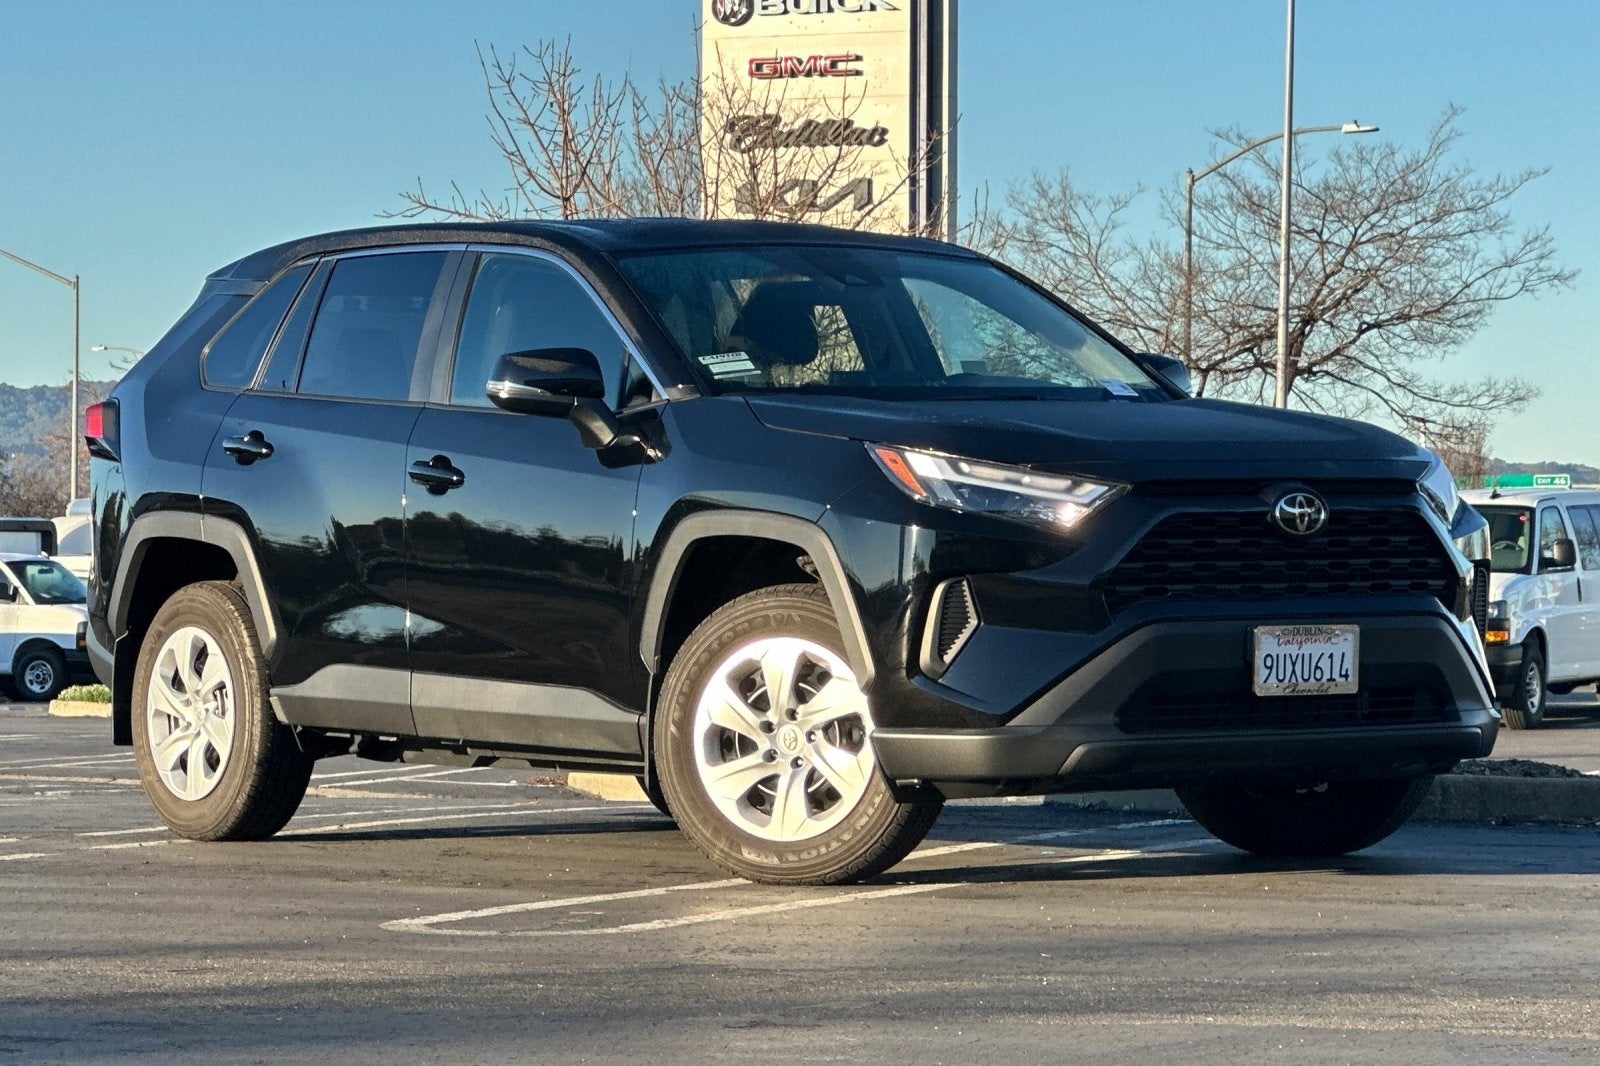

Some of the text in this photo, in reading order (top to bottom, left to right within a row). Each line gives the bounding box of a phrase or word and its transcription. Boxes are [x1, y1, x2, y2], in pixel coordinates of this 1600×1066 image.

[748, 53, 863, 79] GMC
[1292, 626, 1324, 636] DUBLIN
[1277, 635, 1339, 651] California
[1262, 652, 1350, 684] 9UXU614
